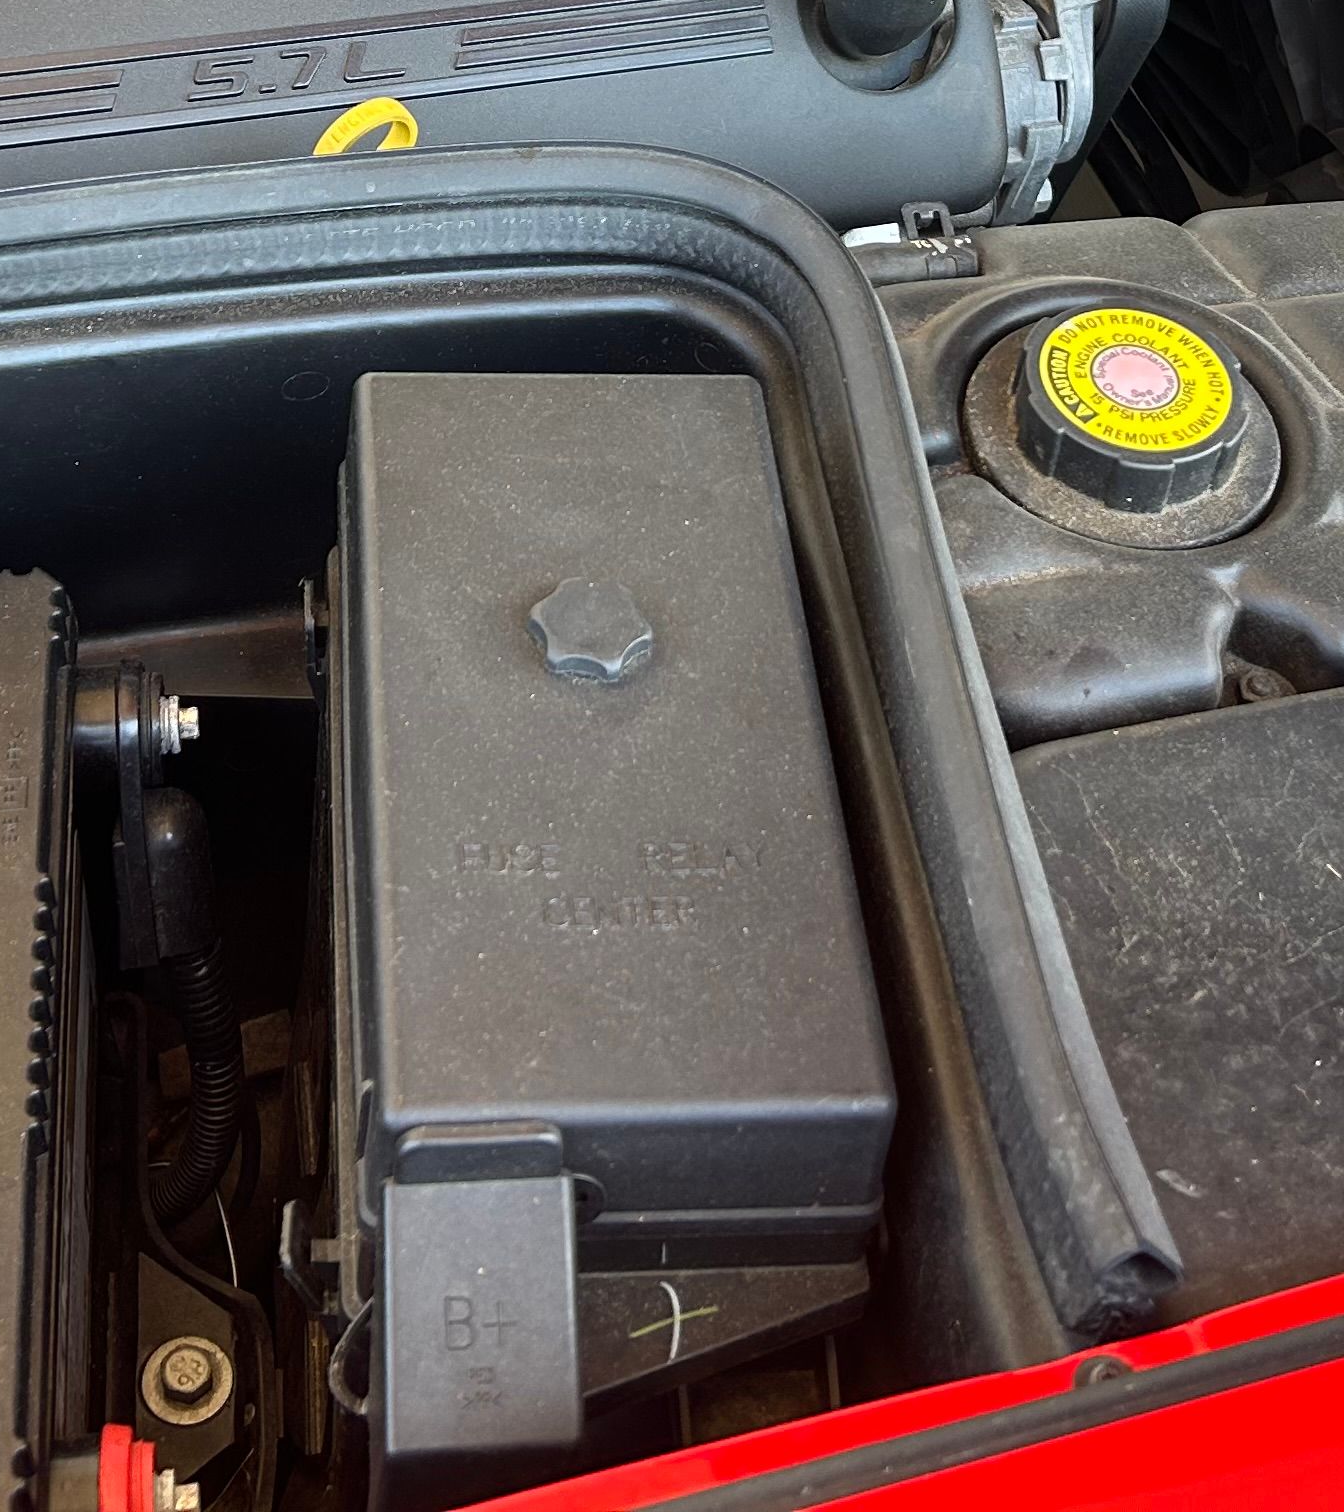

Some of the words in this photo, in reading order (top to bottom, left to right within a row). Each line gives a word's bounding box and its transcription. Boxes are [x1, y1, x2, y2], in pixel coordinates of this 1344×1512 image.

[189, 41, 407, 103] 5.7L
[1058, 328, 1078, 344] DO
[1075, 315, 1105, 333] NOT
[1110, 314, 1177, 337] REMOVE
[1075, 337, 1108, 379] ENGINE
[1112, 333, 1189, 370] COOLANT
[1178, 334, 1216, 368] WHEN
[1050, 349, 1076, 405] CAUTION
[1207, 371, 1224, 394] HOT
[1090, 392, 1105, 405] 15
[1109, 404, 1134, 421] PSI
[1141, 378, 1196, 422] PRESSURE
[1103, 424, 1169, 446] REMOVE
[1172, 405, 1219, 442] SLOWLY
[457, 840, 561, 875] FUSE
[641, 839, 768, 874] RELAY
[541, 895, 700, 929] CENTER
[442, 1294, 520, 1354] B+
